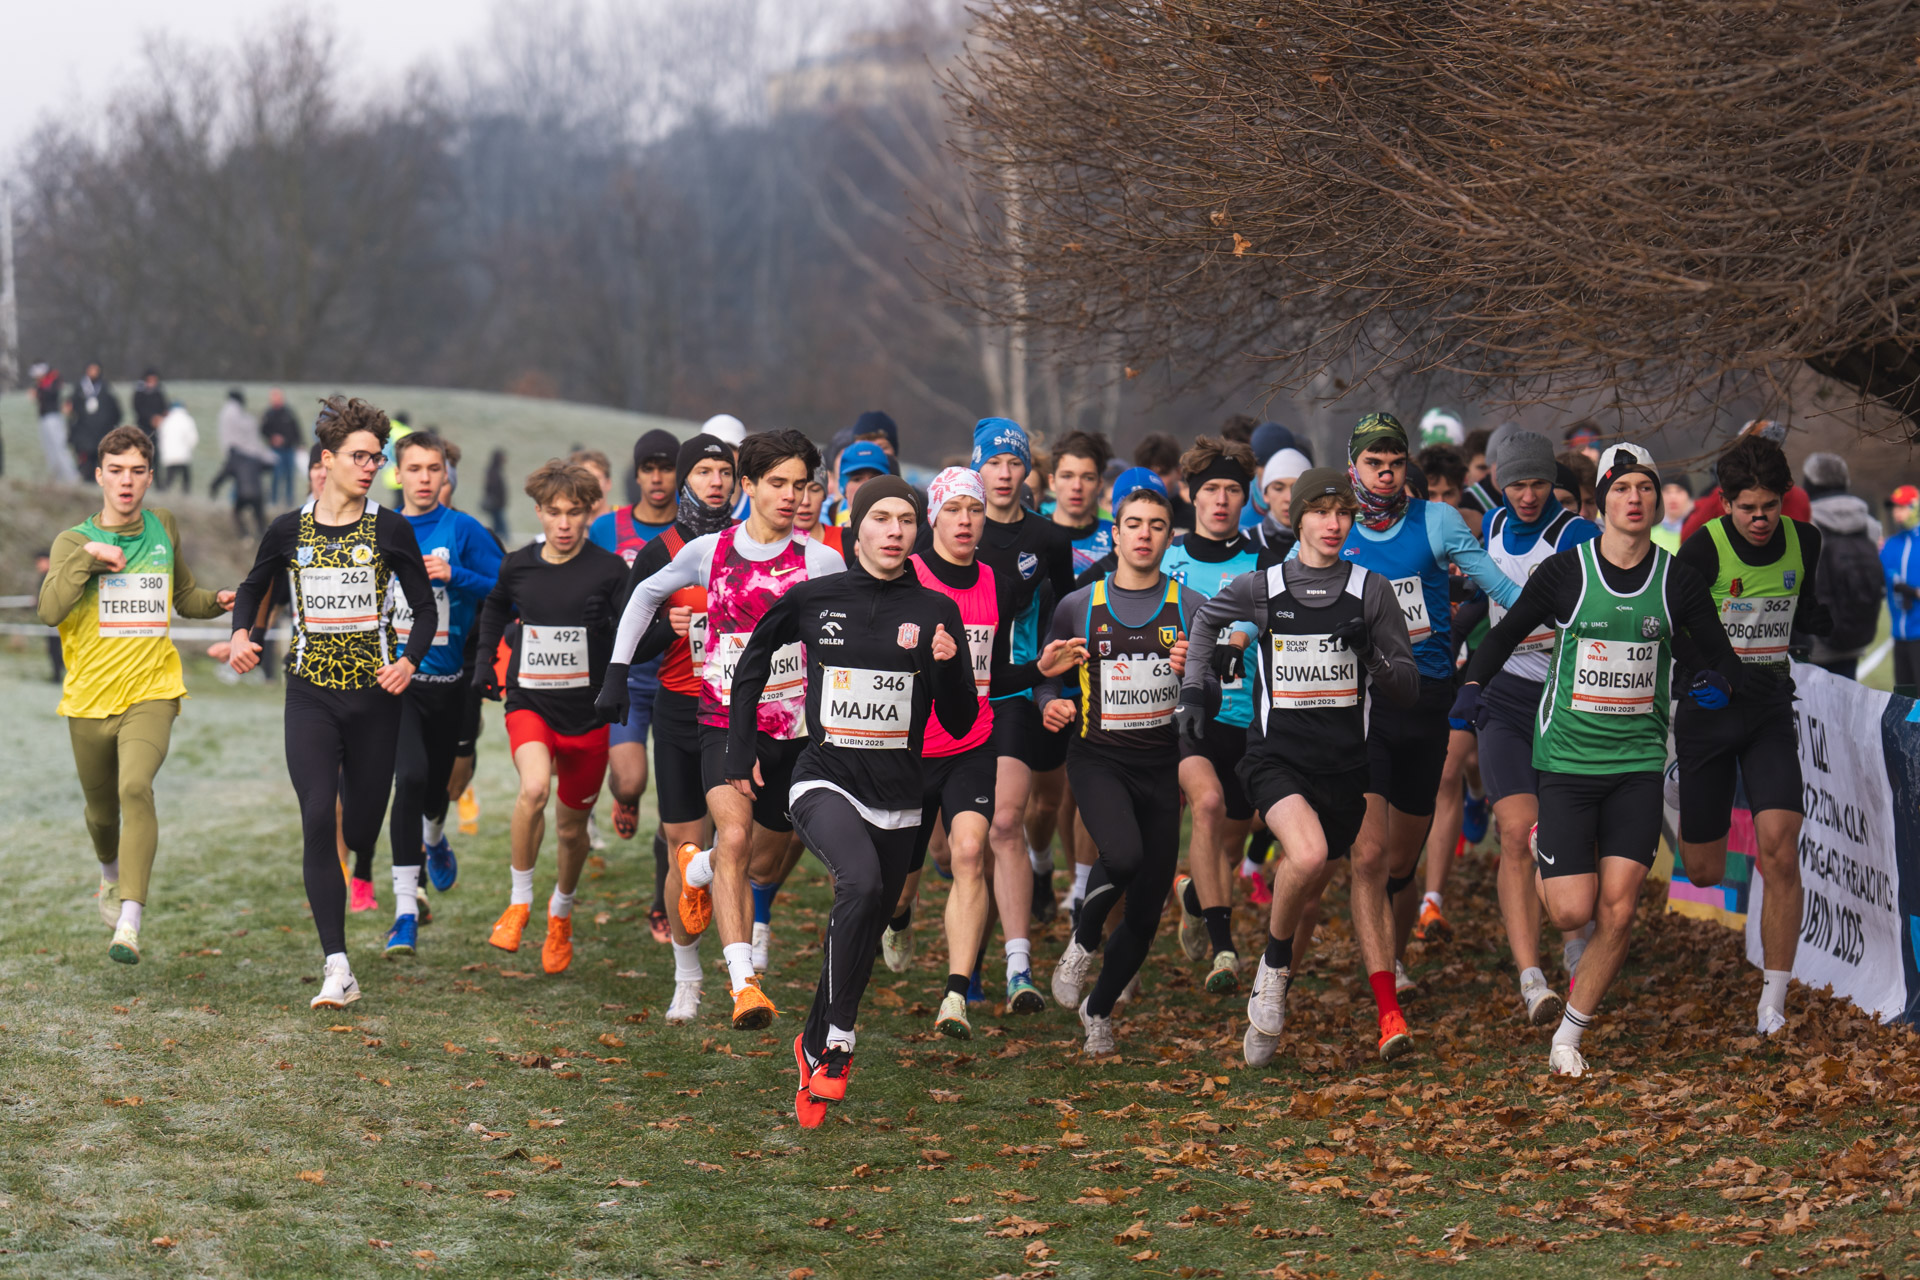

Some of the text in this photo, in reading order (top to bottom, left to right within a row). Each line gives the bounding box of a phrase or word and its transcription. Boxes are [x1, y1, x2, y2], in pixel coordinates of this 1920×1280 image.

[140, 578, 163, 589] 380
[341, 571, 368, 584] 262
[102, 600, 165, 614] TEREBUN
[306, 594, 372, 609] BORZYM
[1731, 603, 1752, 611] RCS
[1764, 600, 1790, 612] 362
[1276, 610, 1294, 619] esa
[553, 630, 580, 642] 492
[528, 652, 578, 666] GAWEŁ
[1627, 646, 1652, 660] 102
[1152, 663, 1172, 677] 63
[1276, 664, 1354, 682] SUWALSKI
[873, 675, 905, 691] 346
[1578, 669, 1654, 688] SOBIESIAK
[1104, 685, 1178, 705] MIZIKOWSKI
[830, 700, 899, 721] MAJKA
[1800, 886, 1864, 968] UBIN 2025
